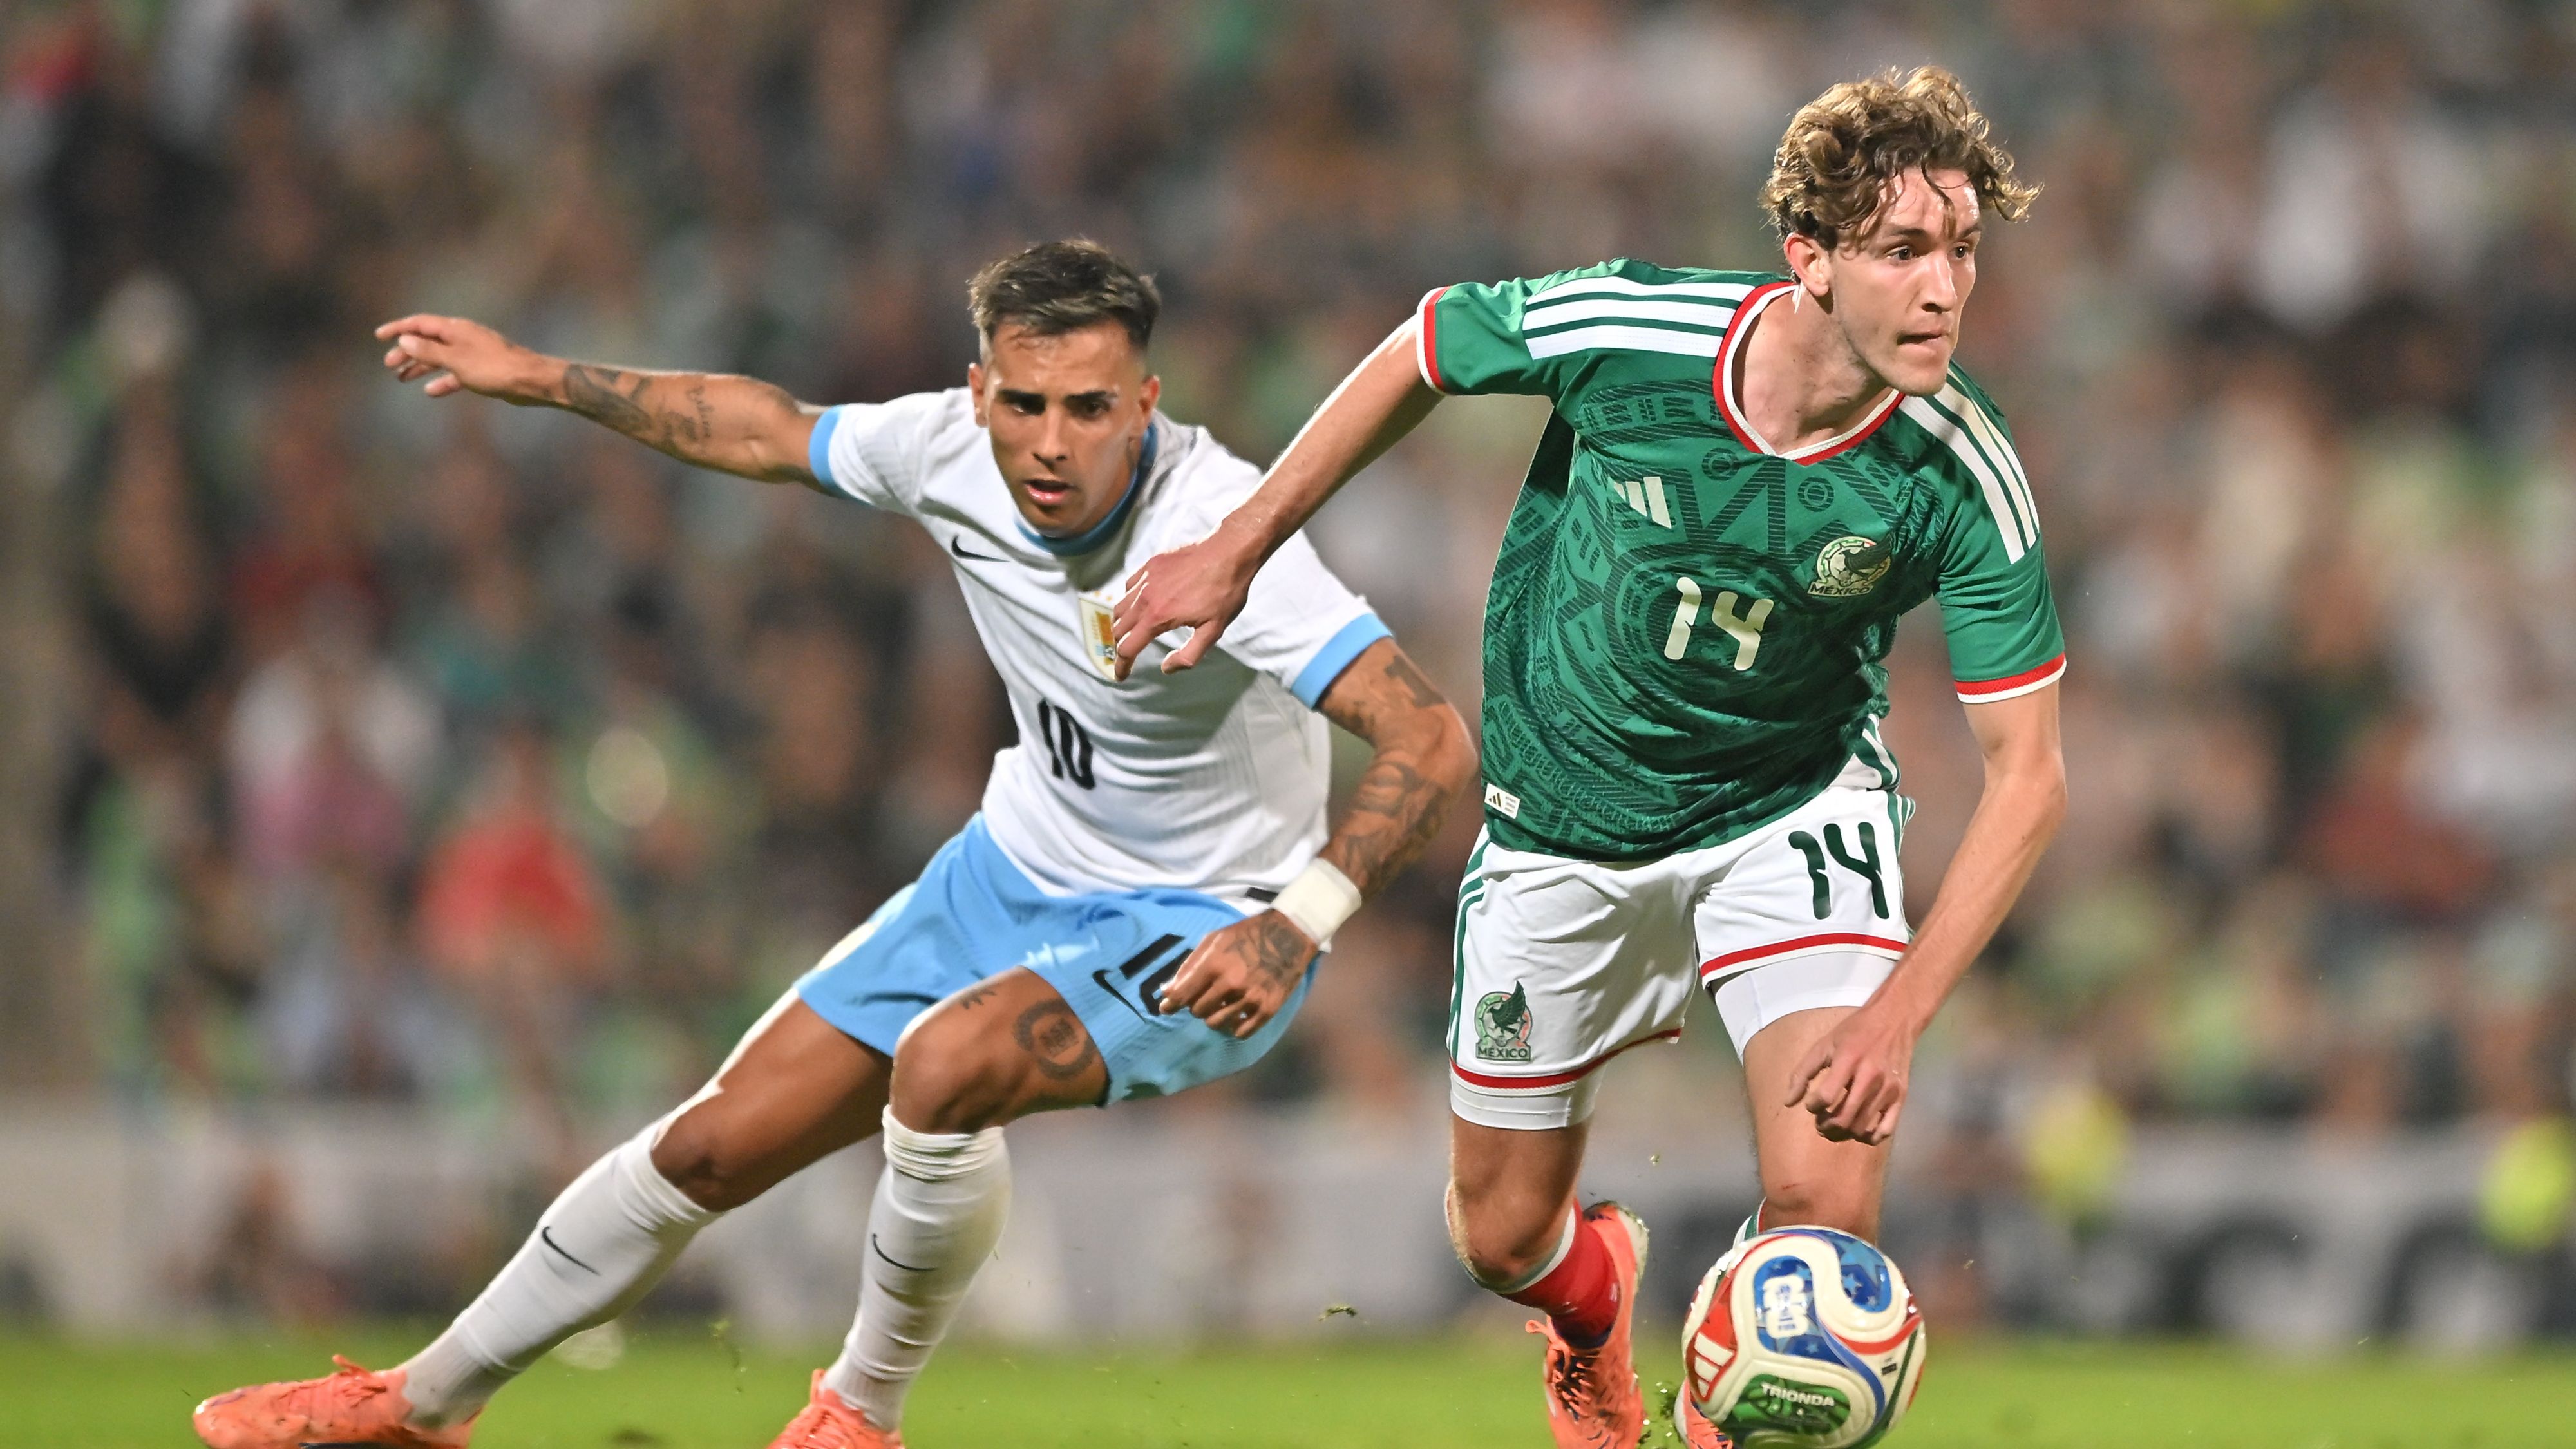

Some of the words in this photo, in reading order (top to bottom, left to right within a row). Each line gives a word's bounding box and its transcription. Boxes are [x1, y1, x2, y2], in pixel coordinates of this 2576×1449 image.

[1664, 577, 1774, 670] 14
[1038, 697, 1095, 790] 10
[1788, 822, 1889, 920] 14
[1761, 1382, 1835, 1406] TRIONDA
